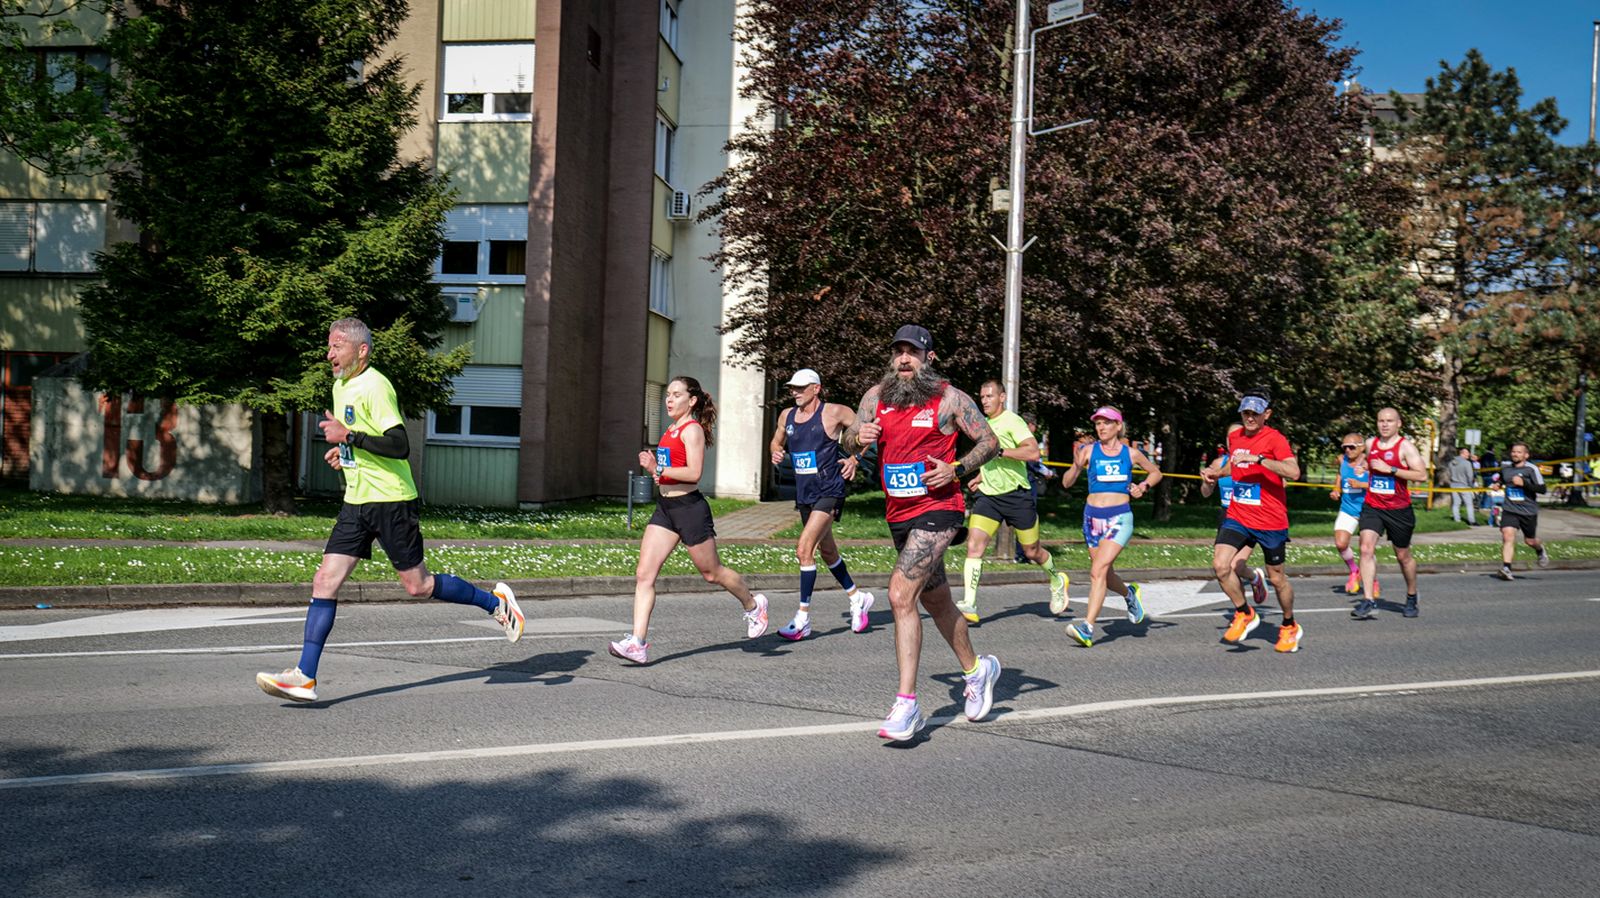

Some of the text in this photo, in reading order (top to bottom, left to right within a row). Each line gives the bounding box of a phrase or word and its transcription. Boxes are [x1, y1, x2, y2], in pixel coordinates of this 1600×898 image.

[98, 392, 177, 481] 13
[796, 457, 811, 468] 487
[1105, 464, 1120, 475] 92
[890, 472, 918, 488] 430
[1373, 479, 1389, 489] 251
[1239, 487, 1252, 498] 24
